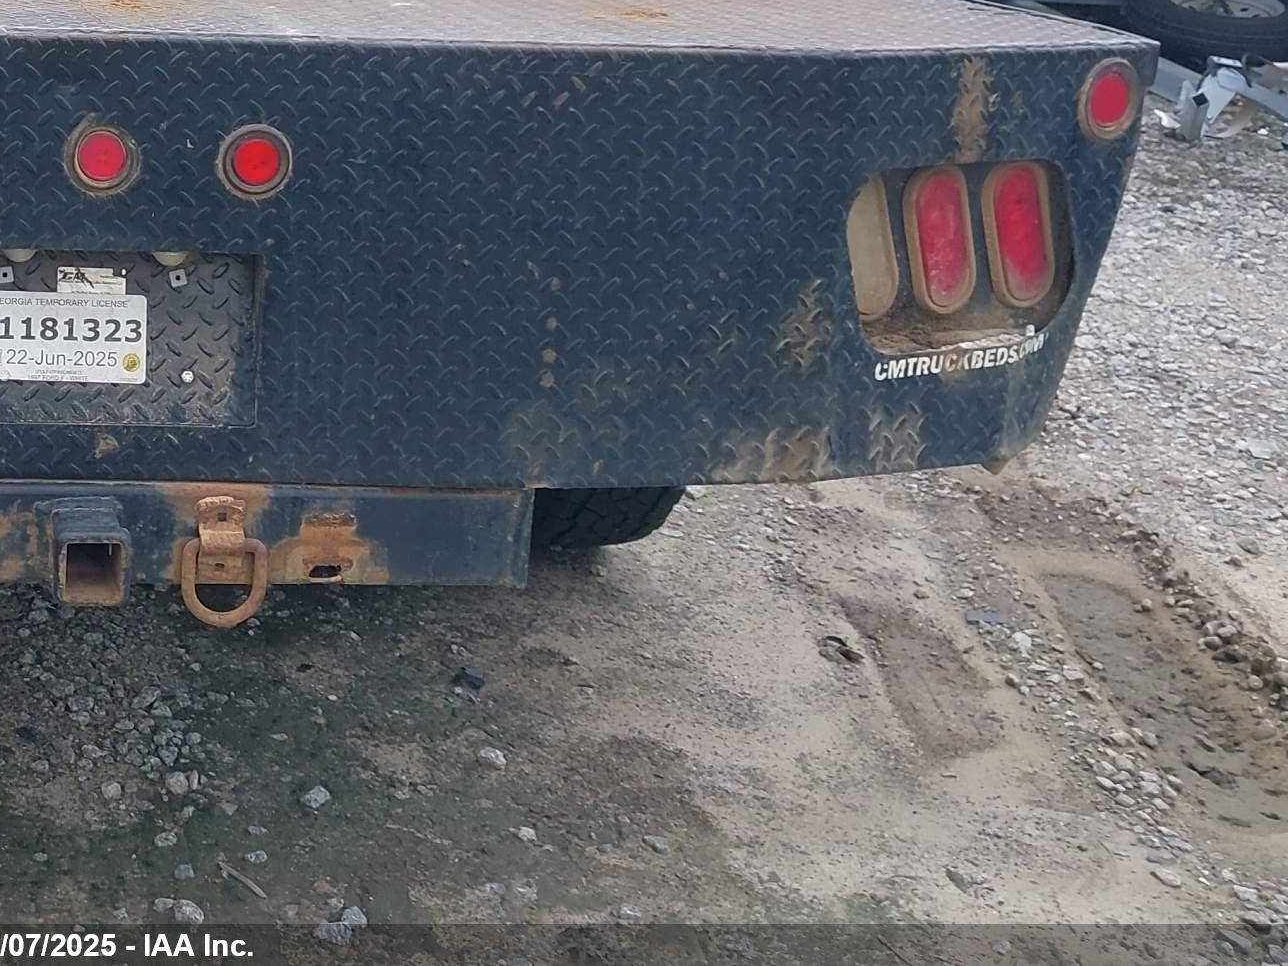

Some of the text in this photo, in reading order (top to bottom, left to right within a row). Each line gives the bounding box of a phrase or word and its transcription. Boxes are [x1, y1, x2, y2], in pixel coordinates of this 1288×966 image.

[35, 297, 90, 307] TEMPORARY
[91, 298, 129, 308] LICENSE
[6, 348, 118, 367] 22-Jun-2025
